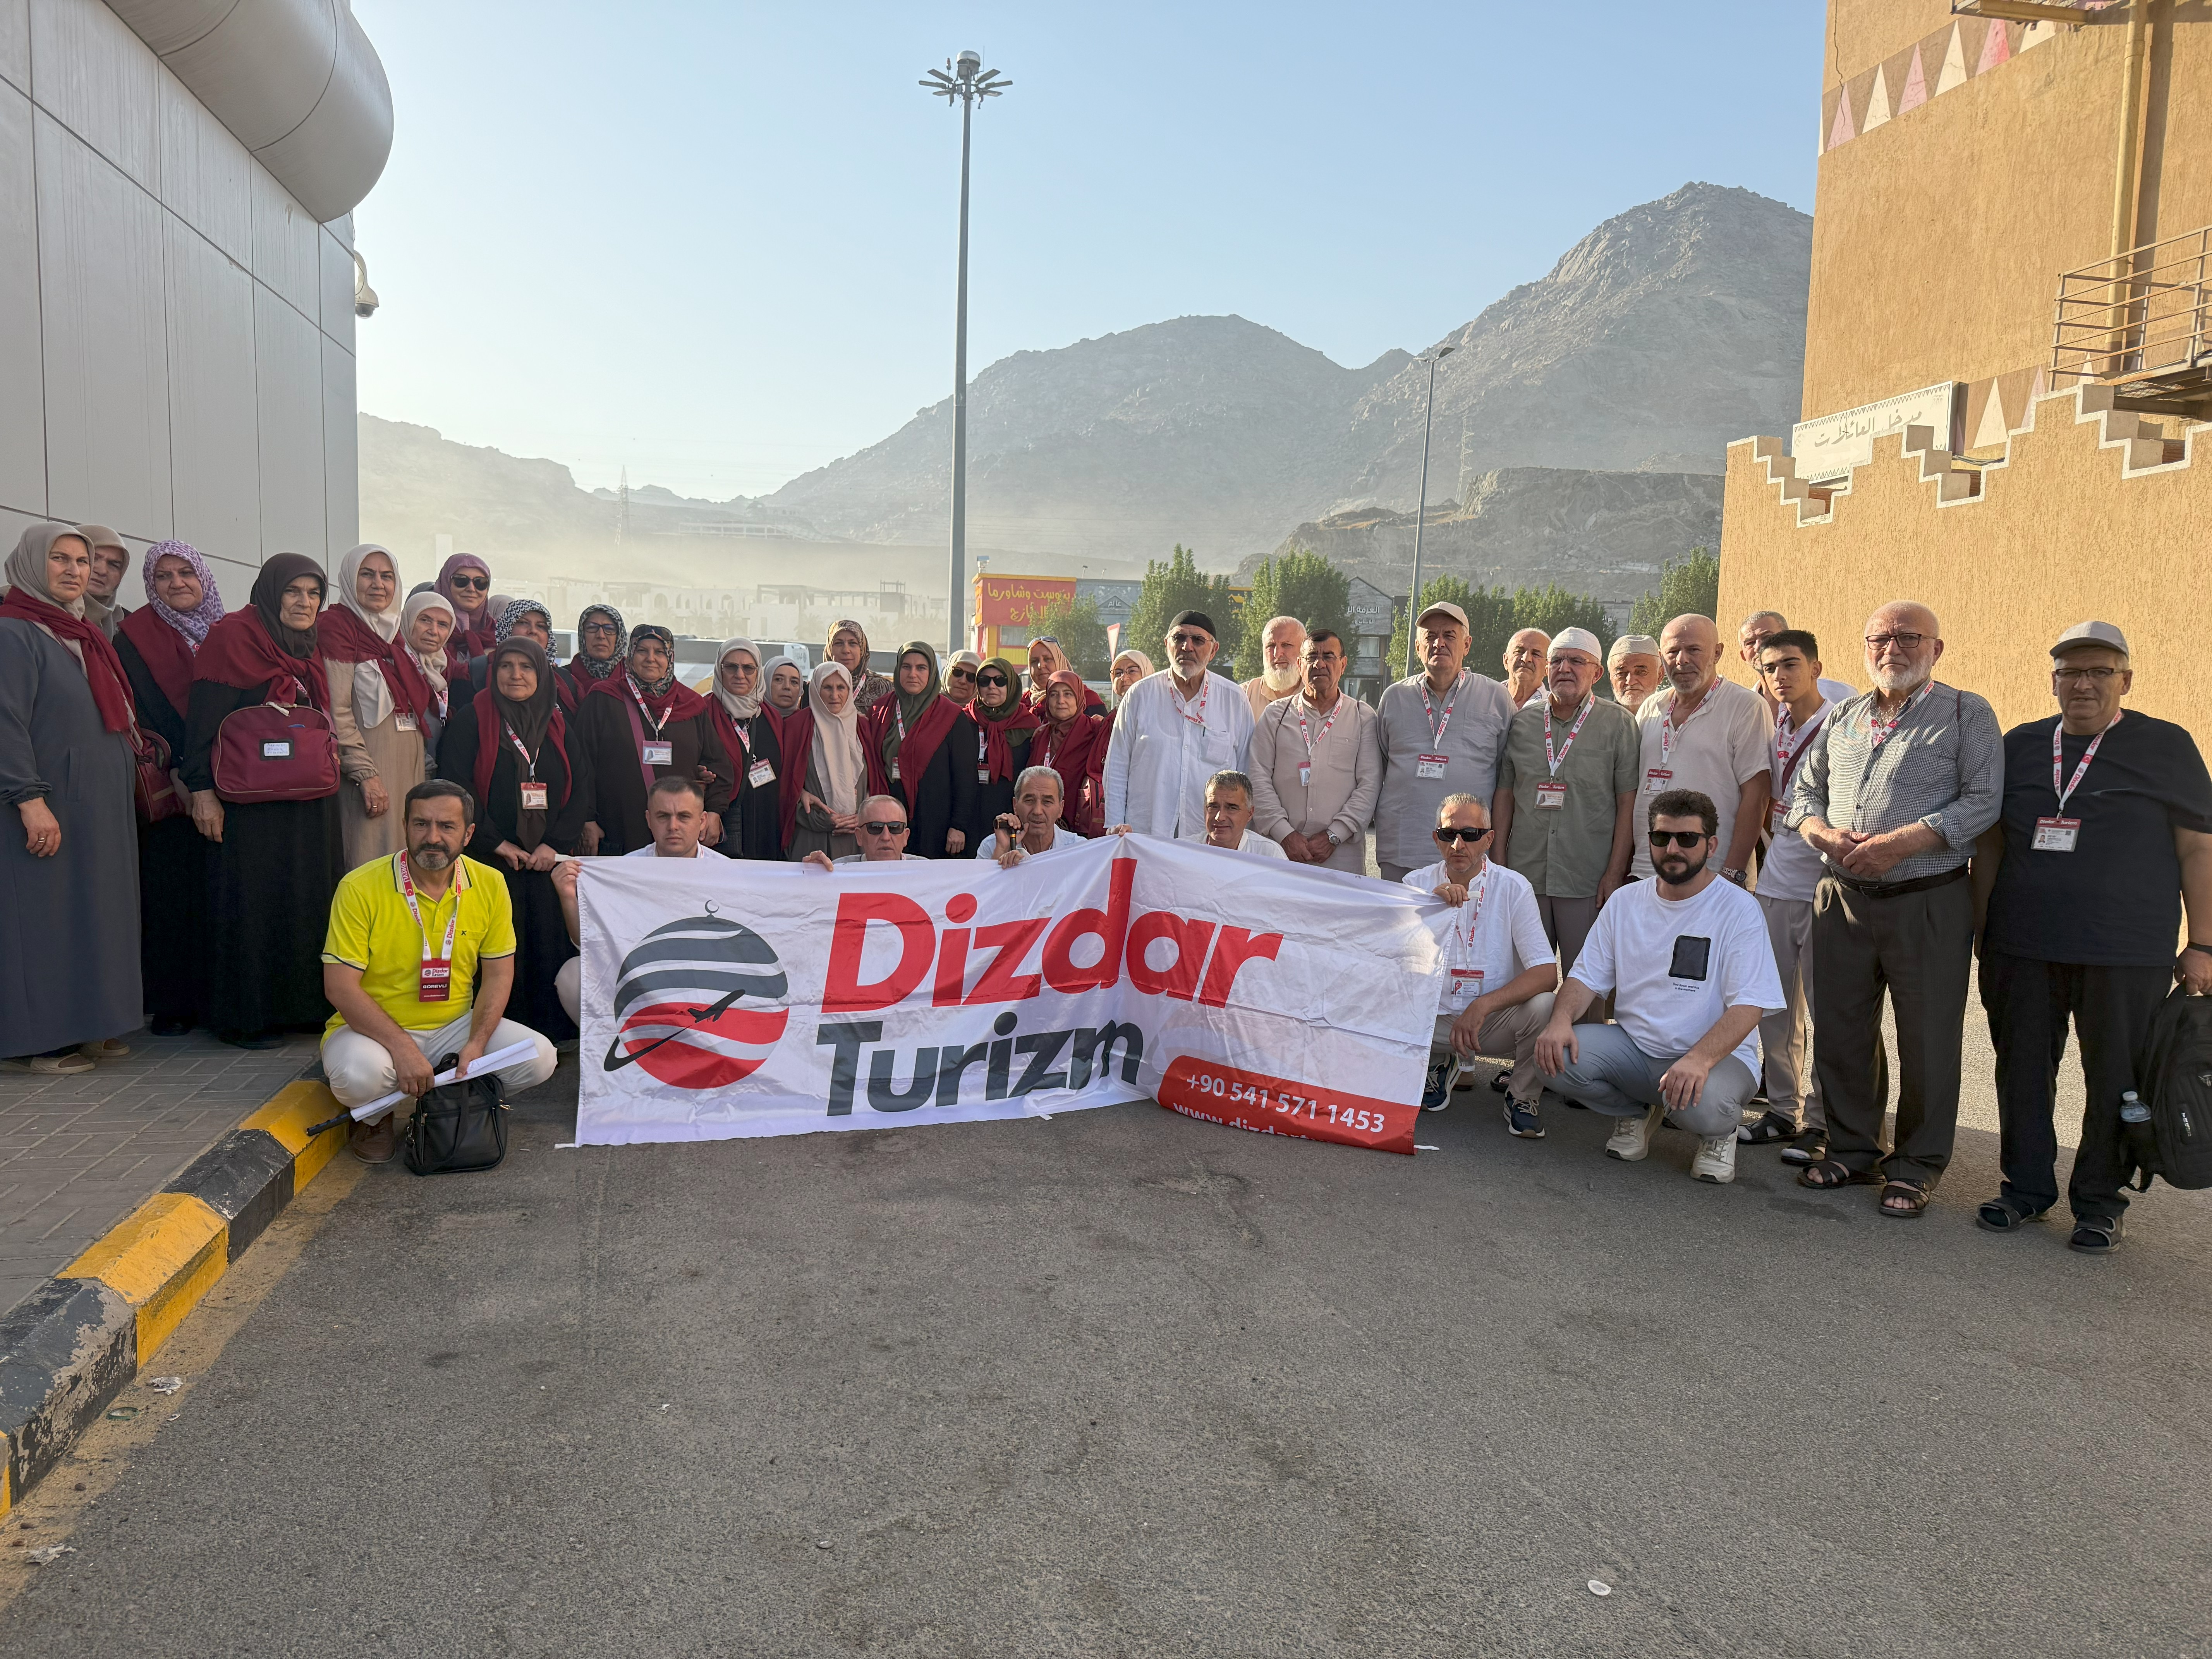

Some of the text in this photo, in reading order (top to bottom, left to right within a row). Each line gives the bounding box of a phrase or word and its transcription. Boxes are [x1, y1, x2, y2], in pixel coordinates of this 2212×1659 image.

[1814, 414, 1875, 448] العائلات
[988, 583, 1031, 601] وشاورما
[1010, 603, 1046, 622] الازج
[1559, 744, 1568, 758] Dizdar
[447, 919, 455, 938] Dizdar
[820, 857, 1284, 1013] Dizdar
[816, 1012, 1144, 1116] Turizm
[1186, 1075, 1385, 1133] +90 541 571 1453
